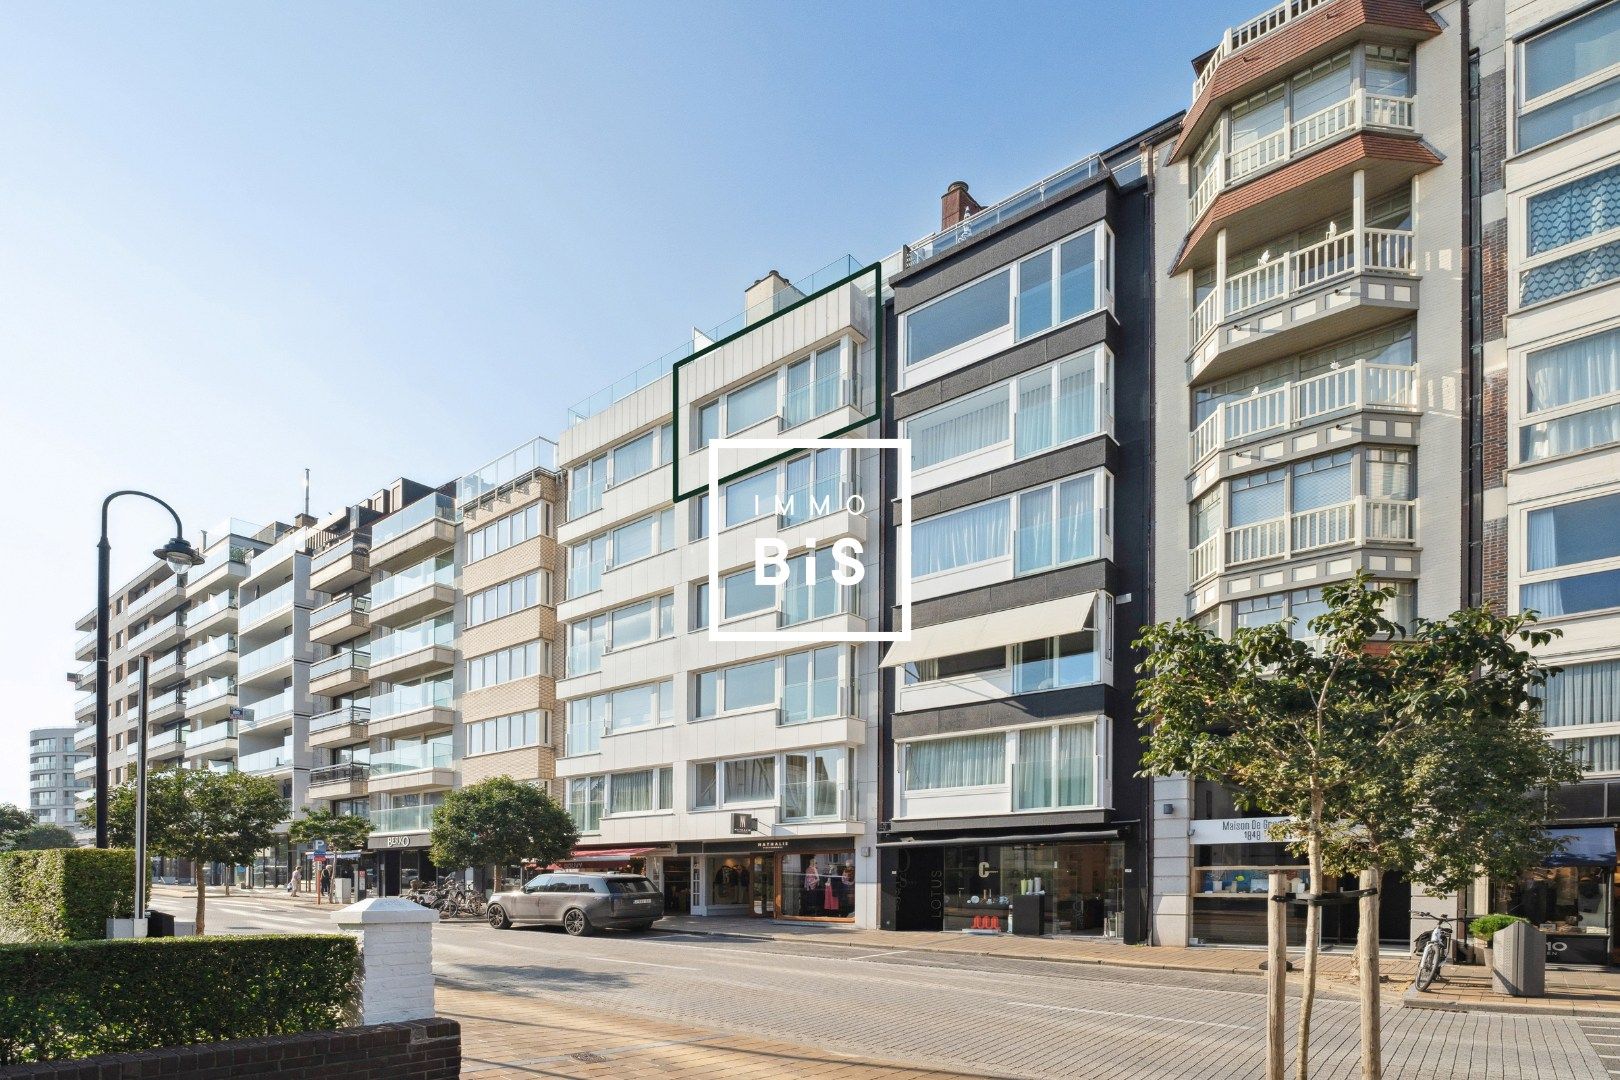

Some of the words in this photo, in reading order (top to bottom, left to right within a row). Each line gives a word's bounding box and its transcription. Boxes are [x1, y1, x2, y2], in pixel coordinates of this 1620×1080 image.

[1222, 821, 1250, 831] Maison
[1251, 820, 1261, 830] De
[315, 840, 325, 850] P
[930, 870, 943, 918] LOTUS
